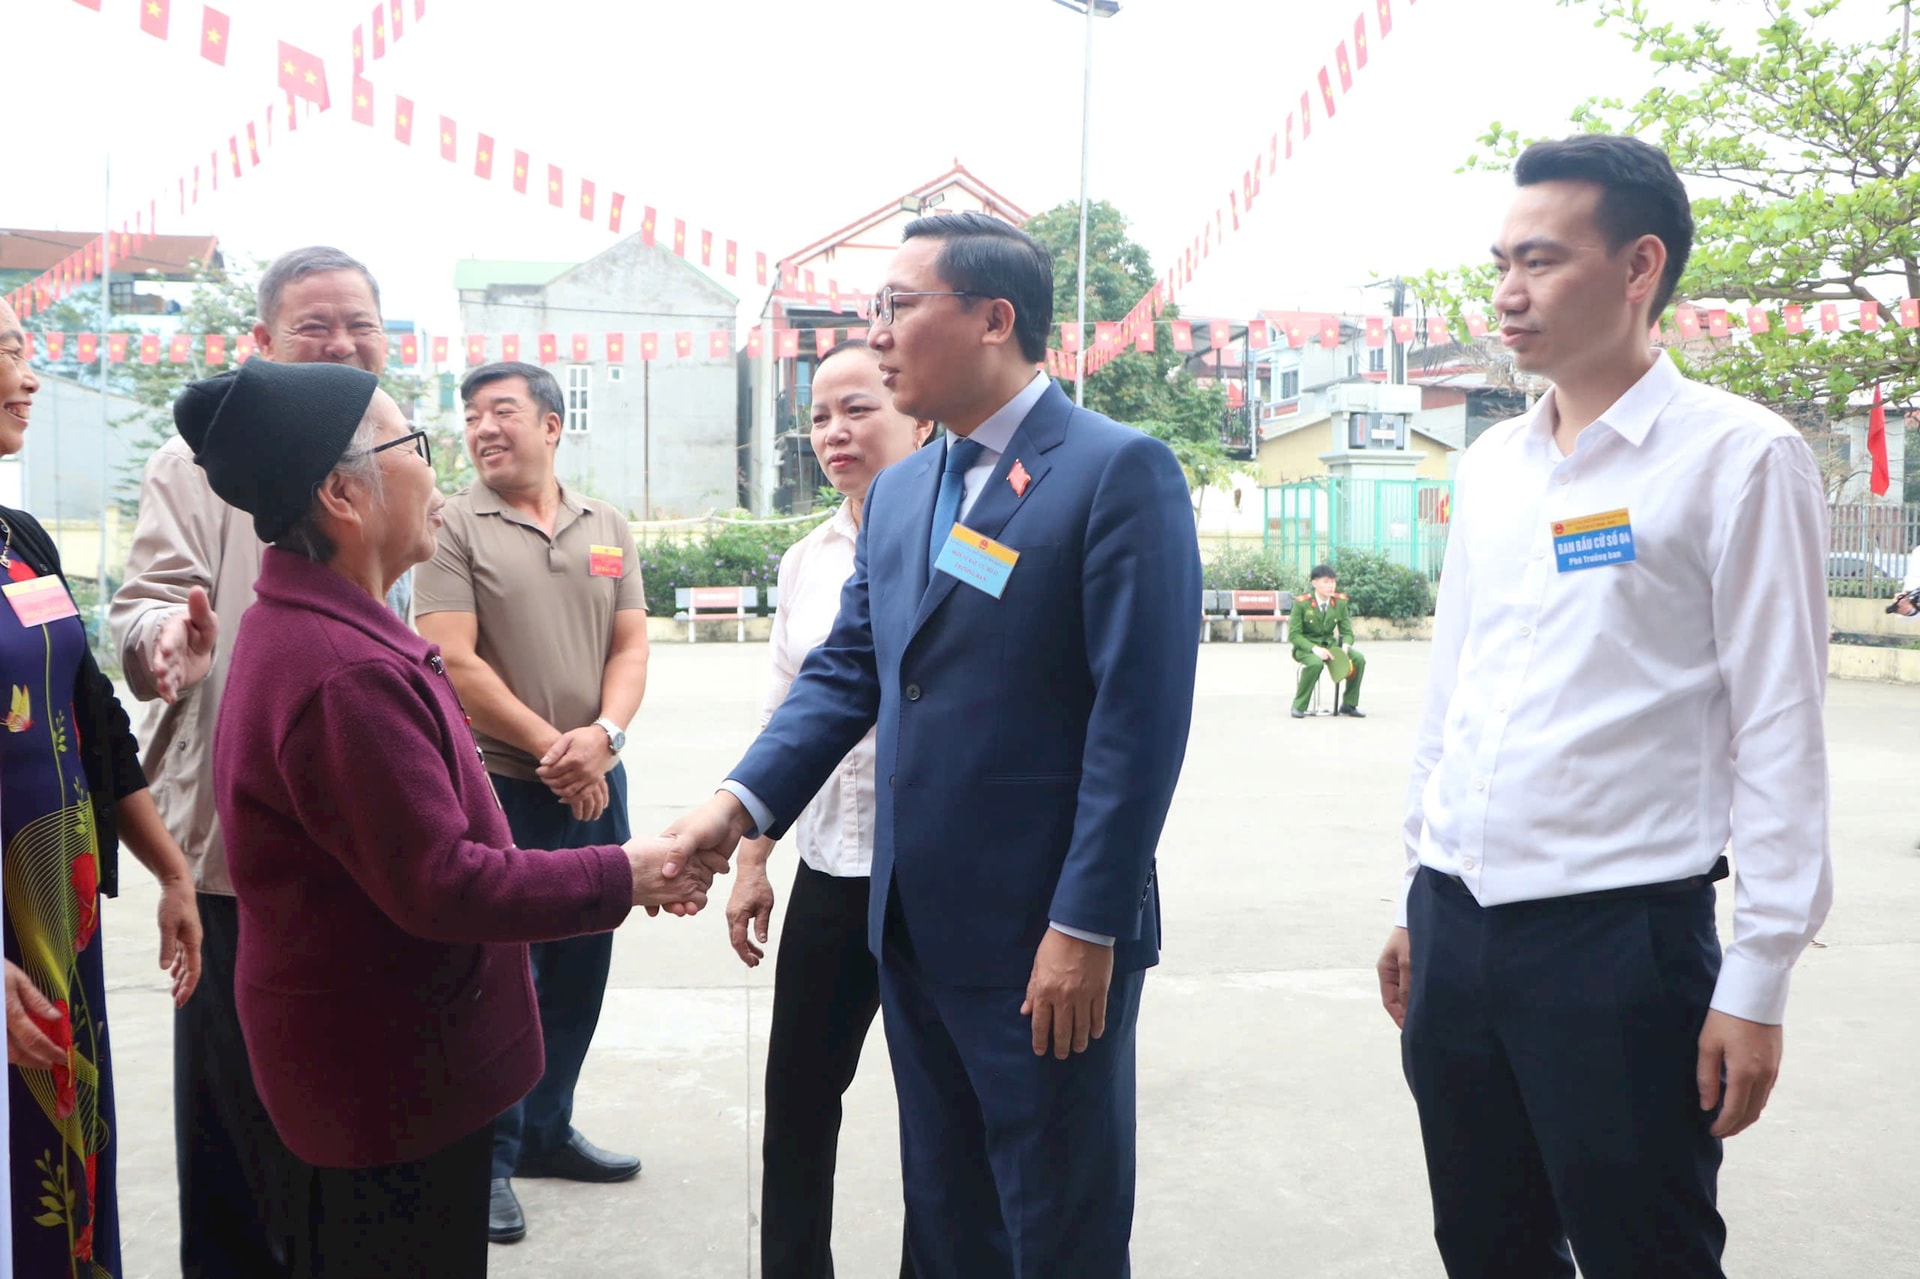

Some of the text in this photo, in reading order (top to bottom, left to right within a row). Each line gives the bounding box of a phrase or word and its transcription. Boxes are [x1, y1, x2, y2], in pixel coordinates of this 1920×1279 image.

[1557, 542, 1575, 554] BAN
[1607, 530, 1618, 546] SỐ
[1608, 551, 1621, 559] ban
